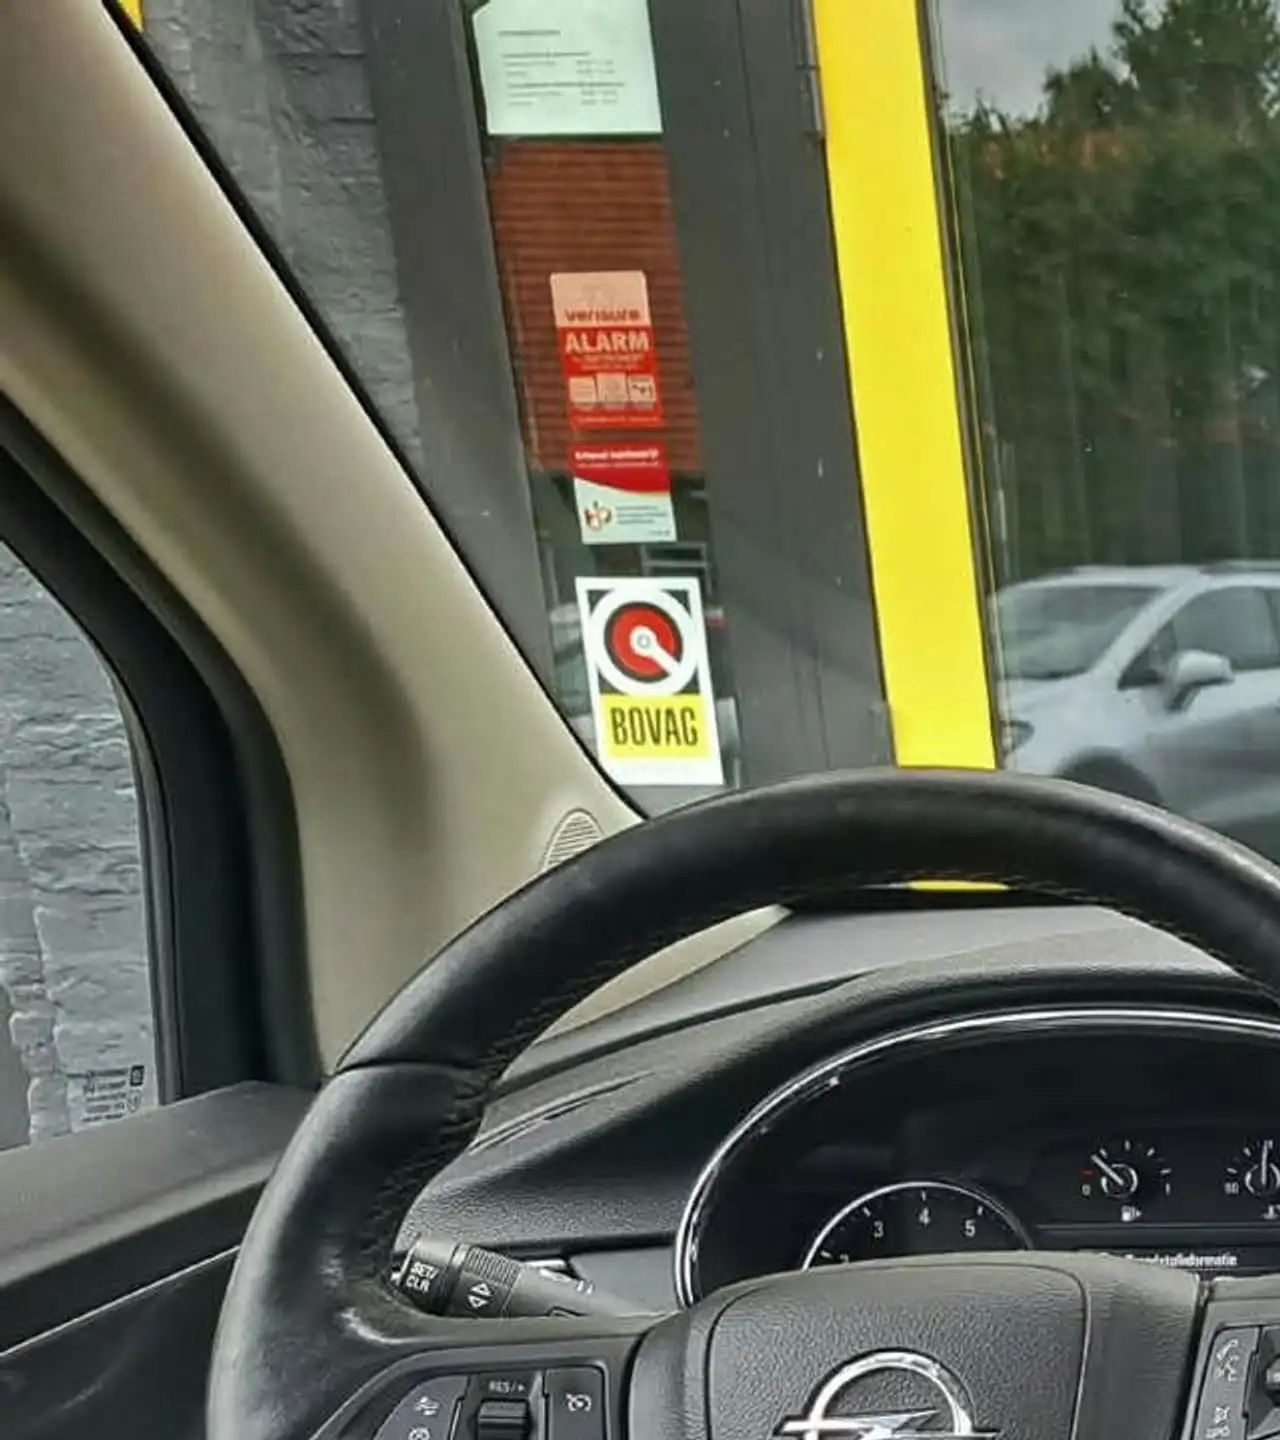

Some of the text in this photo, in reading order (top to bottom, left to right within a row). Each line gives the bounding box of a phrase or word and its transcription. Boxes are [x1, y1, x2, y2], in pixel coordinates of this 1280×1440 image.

[565, 330, 650, 354] ALARM
[610, 706, 700, 747] BOVAG
[919, 1207, 931, 1227] 4
[874, 1221, 885, 1238] 3
[964, 1218, 976, 1238] 5
